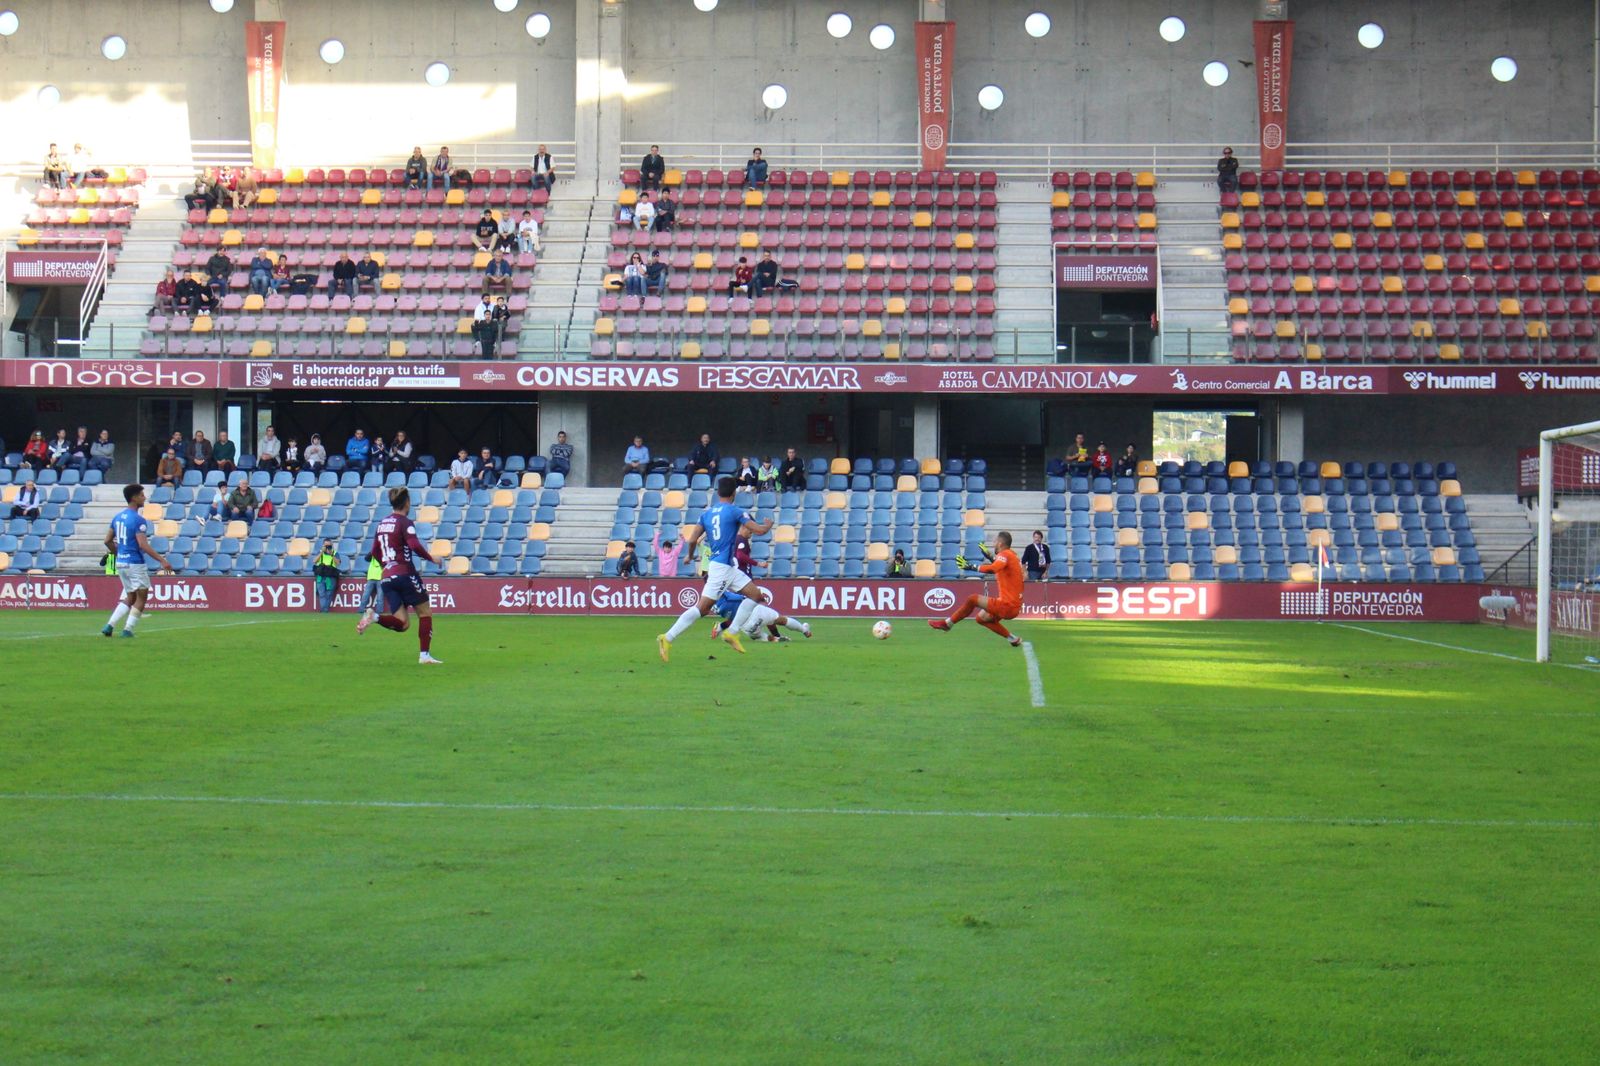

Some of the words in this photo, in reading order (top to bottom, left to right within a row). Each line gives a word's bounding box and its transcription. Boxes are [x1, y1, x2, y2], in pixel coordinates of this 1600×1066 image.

[925, 57, 931, 69] DE
[1263, 56, 1270, 68] DE
[934, 33, 944, 113] PONTEVEDRA
[1272, 32, 1282, 112] PONTEVEDRA
[45, 260, 96, 270] DEPUTACIÓN
[45, 269, 97, 277] PONTEVEDRA
[1095, 264, 1148, 274] DEPUTACIÓN
[1095, 273, 1149, 282] PONTEVEDRA
[91, 361, 144, 372] Frutas
[292, 364, 303, 375] El
[306, 364, 367, 375] ahorrador
[368, 365, 395, 377] para
[398, 365, 411, 376] tu
[413, 364, 446, 376] tarifa
[292, 376, 308, 387] de
[310, 376, 380, 388] electricidad
[516, 366, 679, 388] CONSERVAS
[698, 366, 862, 390] PESCAMAR
[938, 379, 978, 389] ASADOR
[942, 371, 975, 380] HOTEL
[981, 370, 1111, 389] CAMPANIOLA
[1191, 380, 1223, 390] Centro
[1224, 380, 1270, 390] Comercial
[1274, 370, 1293, 390] A
[1300, 370, 1373, 390] Barca
[1427, 372, 1496, 389] hummel
[1542, 372, 1600, 389] humme
[115, 521, 128, 546] 14
[711, 514, 721, 541] 3
[0, 579, 88, 600] ACUÑA
[119, 579, 208, 601] UÑA
[245, 582, 306, 608] BYB
[498, 584, 587, 609] Estrella
[591, 584, 672, 609] Galicia
[1333, 589, 1423, 604] DEPUTACIÓN
[791, 586, 906, 611] MAFARI
[1019, 601, 1092, 614] trucciones
[1333, 604, 1424, 616] PONTEVEDRA
